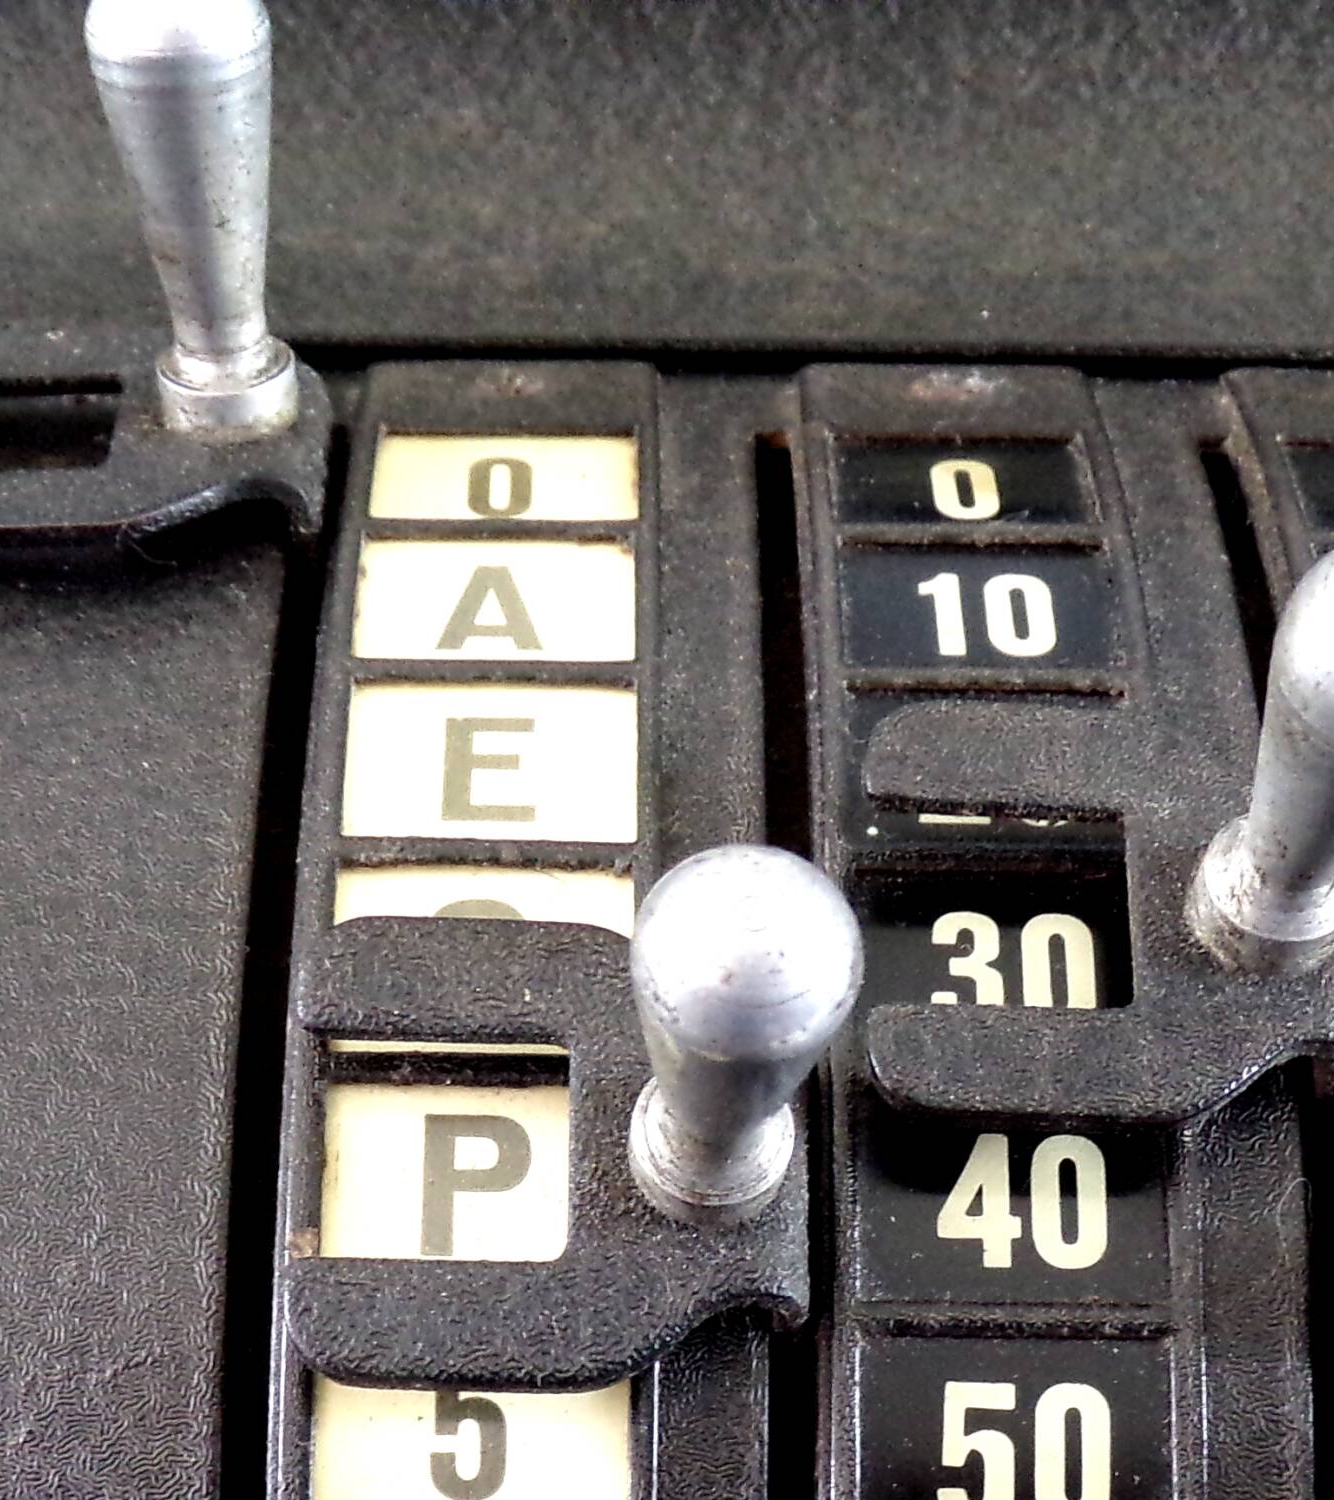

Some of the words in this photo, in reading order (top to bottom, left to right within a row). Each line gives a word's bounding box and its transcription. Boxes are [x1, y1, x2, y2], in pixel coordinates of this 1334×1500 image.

[467, 457, 534, 519] 0
[929, 459, 1001, 520] 0
[436, 565, 543, 651] A
[917, 572, 1058, 658] 10
[441, 717, 536, 823] E
[930, 911, 1098, 1009] 30
[419, 1113, 532, 1256] P
[936, 1133, 1109, 1270] 40
